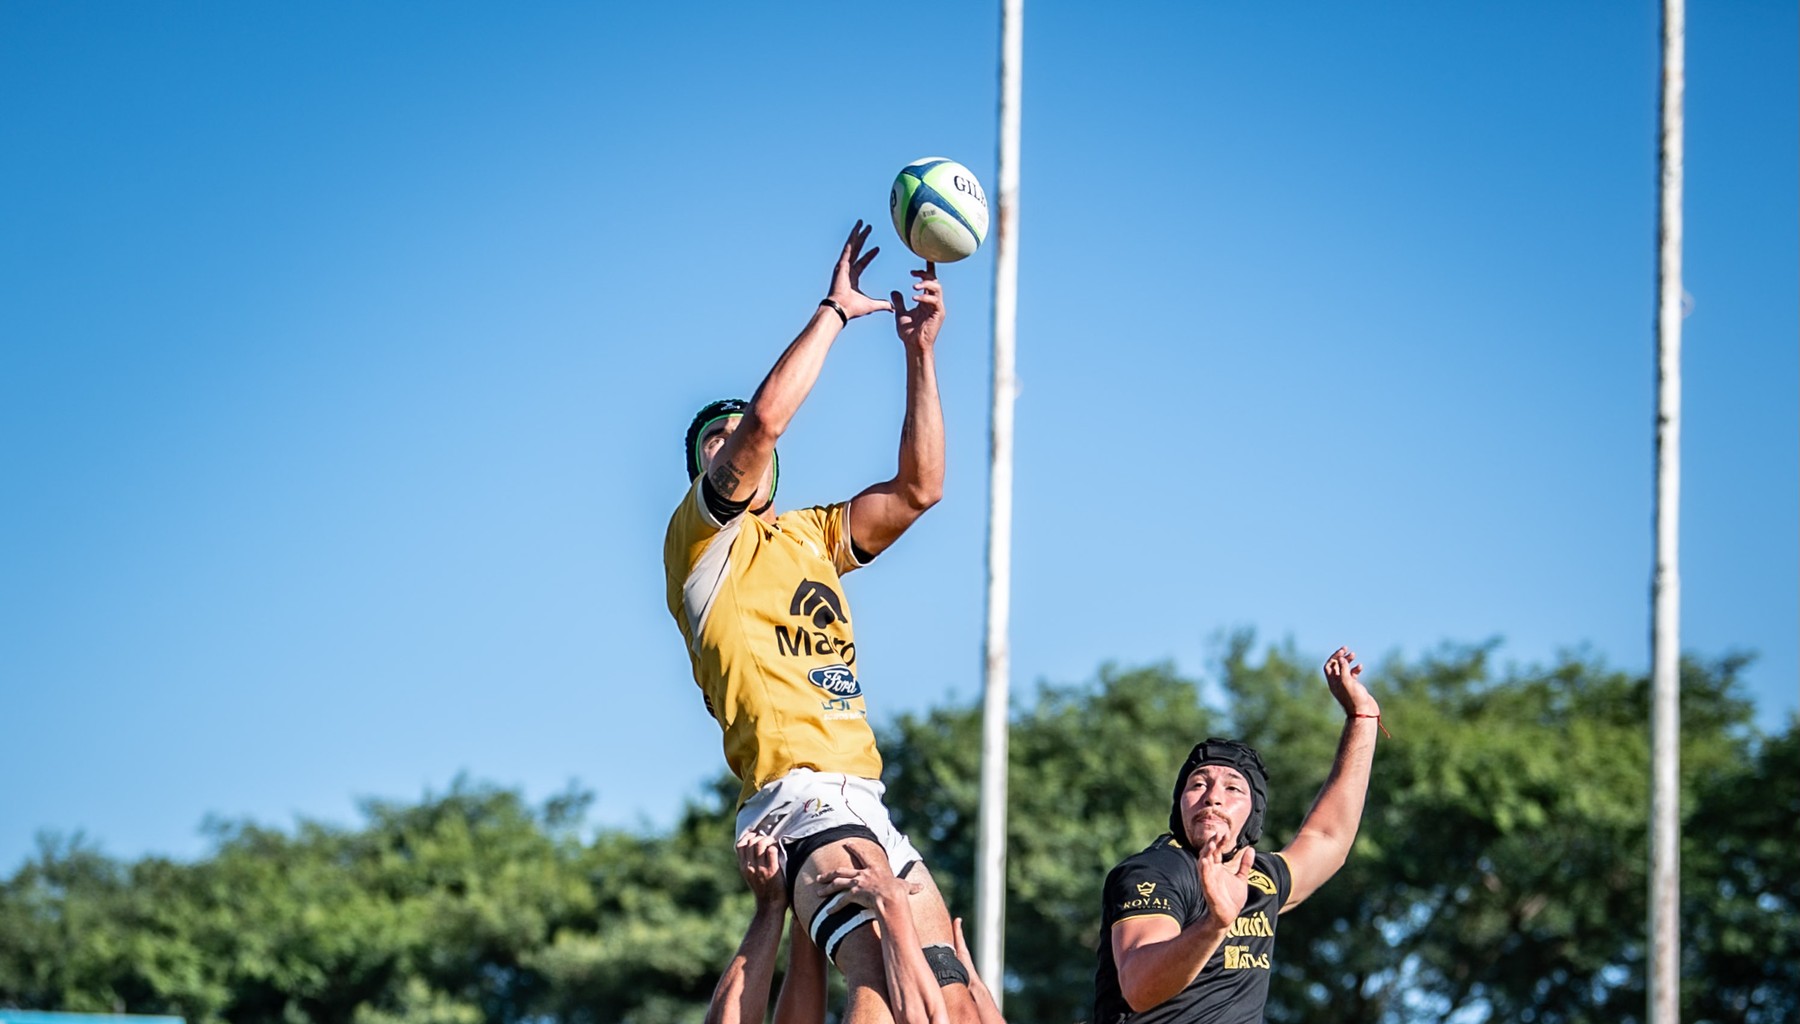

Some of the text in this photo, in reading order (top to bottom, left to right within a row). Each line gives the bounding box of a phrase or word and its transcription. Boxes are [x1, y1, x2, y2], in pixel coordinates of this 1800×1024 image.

[775, 625, 857, 667] Maro
[822, 669, 857, 694] Ford
[1226, 911, 1274, 938] unich
